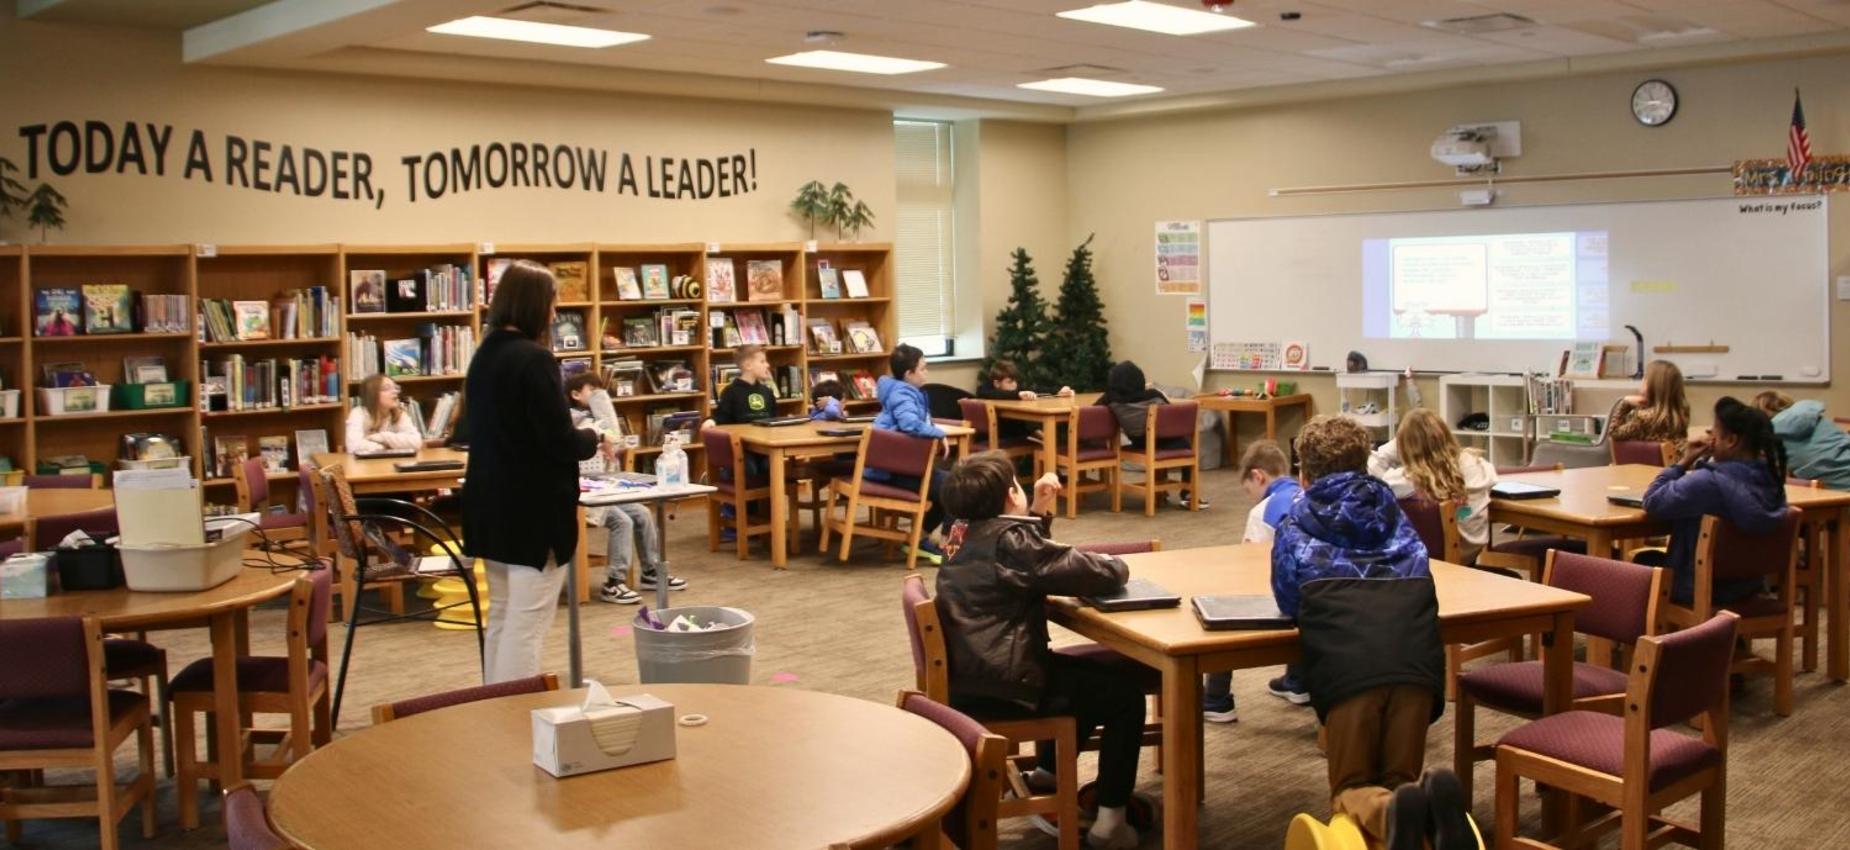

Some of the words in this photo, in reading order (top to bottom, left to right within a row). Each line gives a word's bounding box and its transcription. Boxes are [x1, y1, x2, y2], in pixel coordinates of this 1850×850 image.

[18, 120, 173, 180] TODAY
[183, 129, 214, 183] A
[224, 135, 385, 210] READER,
[401, 142, 607, 202] TOMORROW
[617, 152, 639, 197] A
[645, 148, 758, 200] LEADER!
[1739, 203, 1764, 214] What
[1765, 202, 1773, 213] is
[1775, 204, 1788, 216] my
[1790, 200, 1823, 212] focus?
